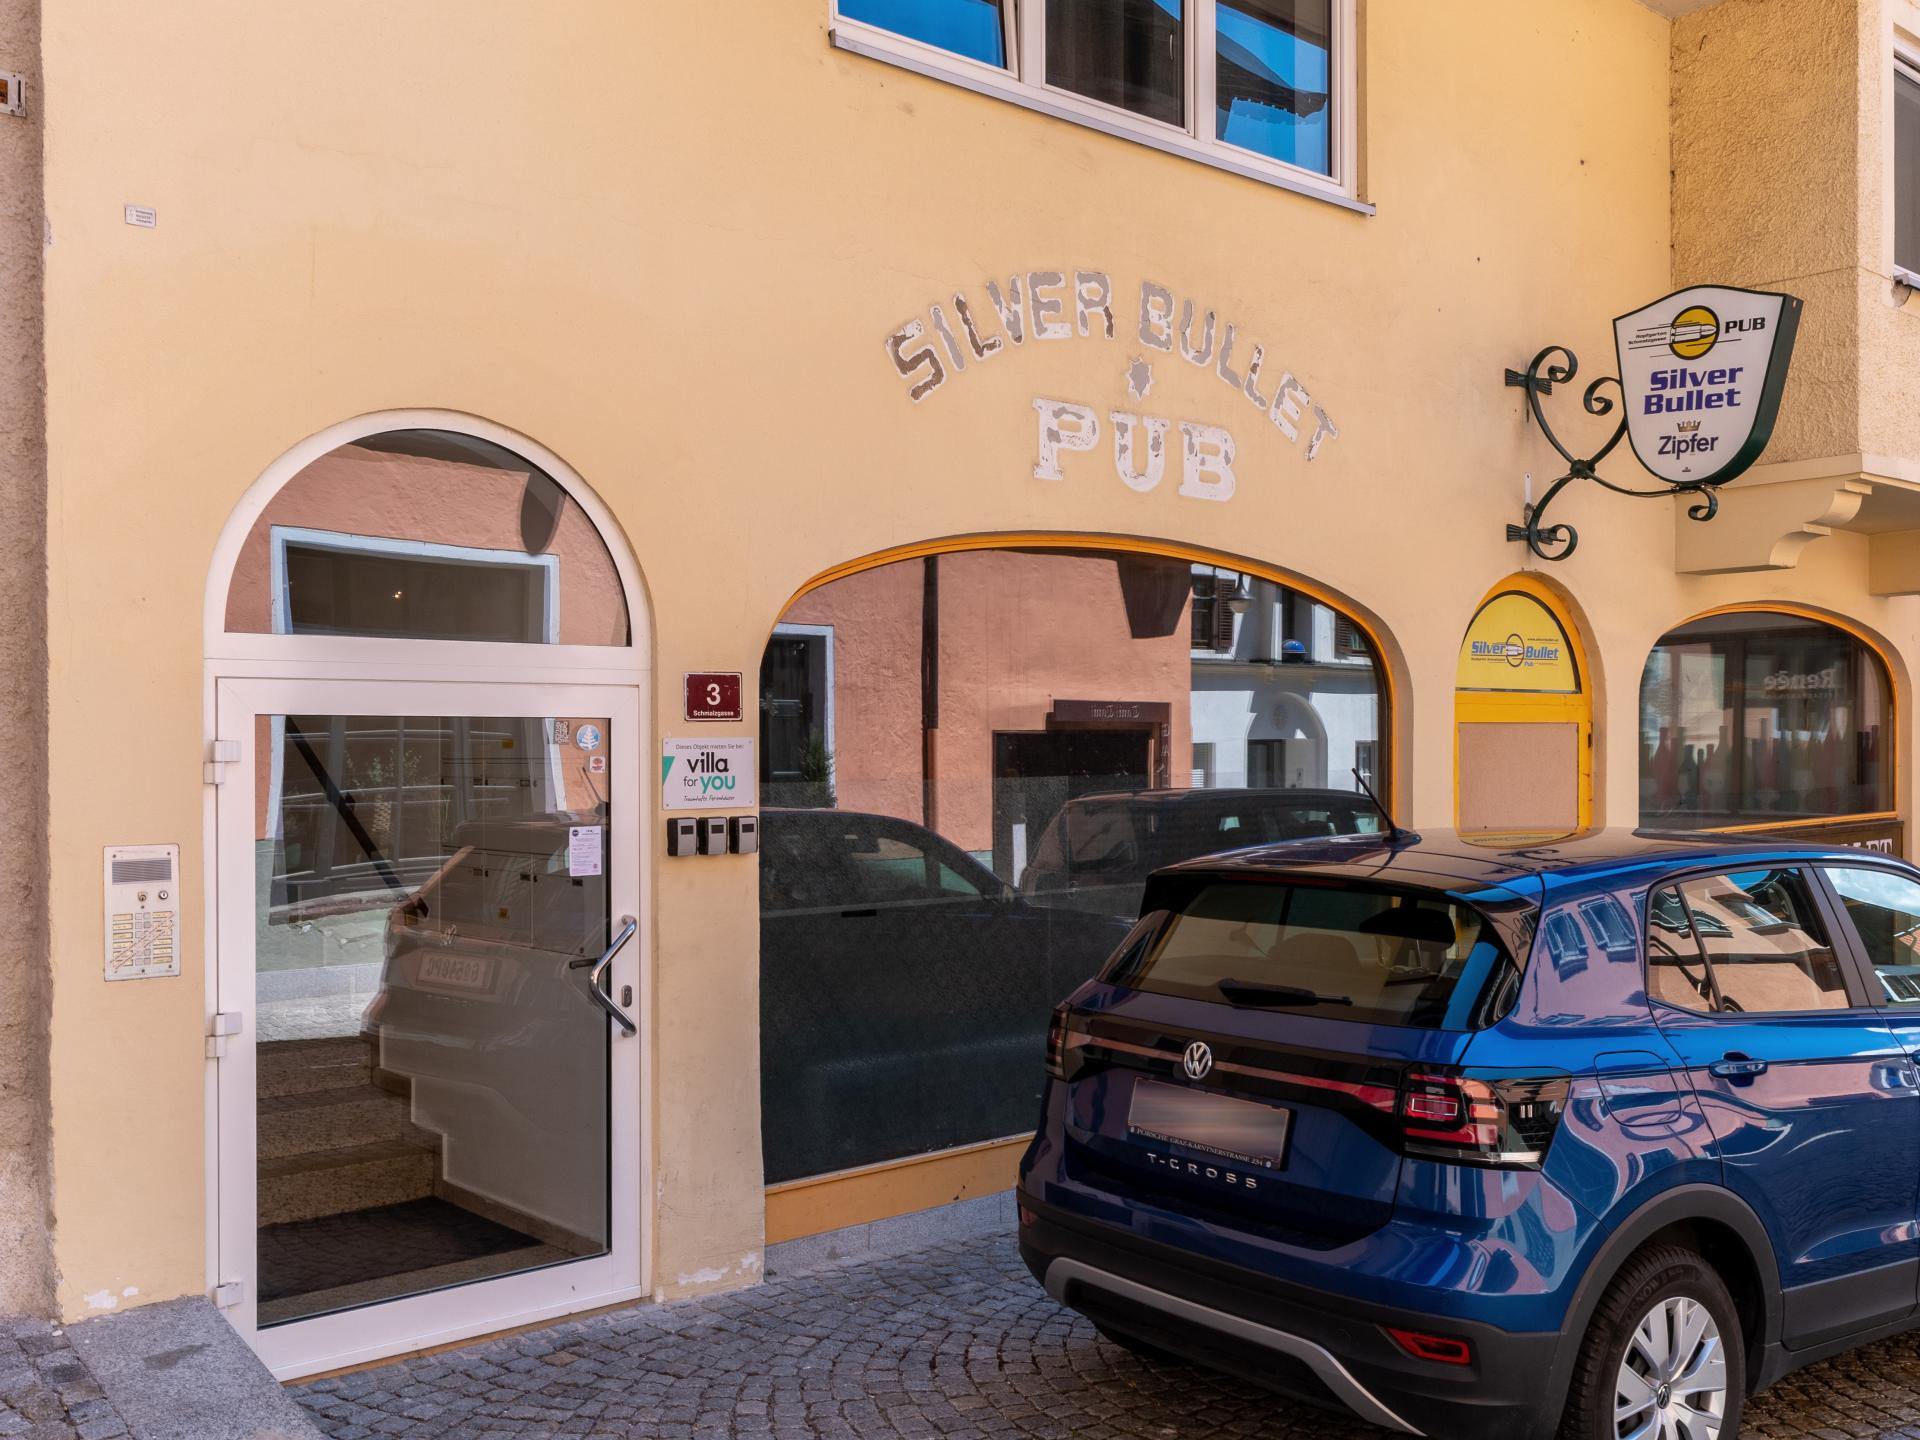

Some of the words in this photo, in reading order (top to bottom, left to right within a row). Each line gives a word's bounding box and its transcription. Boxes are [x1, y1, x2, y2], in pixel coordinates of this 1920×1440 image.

[1724, 317, 1766, 334] PUB
[885, 270, 1114, 403] SILVER
[1138, 280, 1339, 463] BULLET
[1650, 367, 1744, 392] Silver
[1643, 387, 1741, 415] Bullet
[1032, 397, 1236, 501] PUB
[1657, 432, 1719, 460] Zipfer
[1471, 641, 1506, 655] Silver
[1525, 645, 1559, 659] Bullet
[706, 683, 721, 706] 3
[693, 709, 734, 718] Schmalzgasse
[693, 743, 709, 751] Objekt
[686, 751, 730, 773] villa
[683, 775, 698, 787] for
[699, 775, 736, 794] you
[1147, 1152, 1258, 1189] T-CROSS
